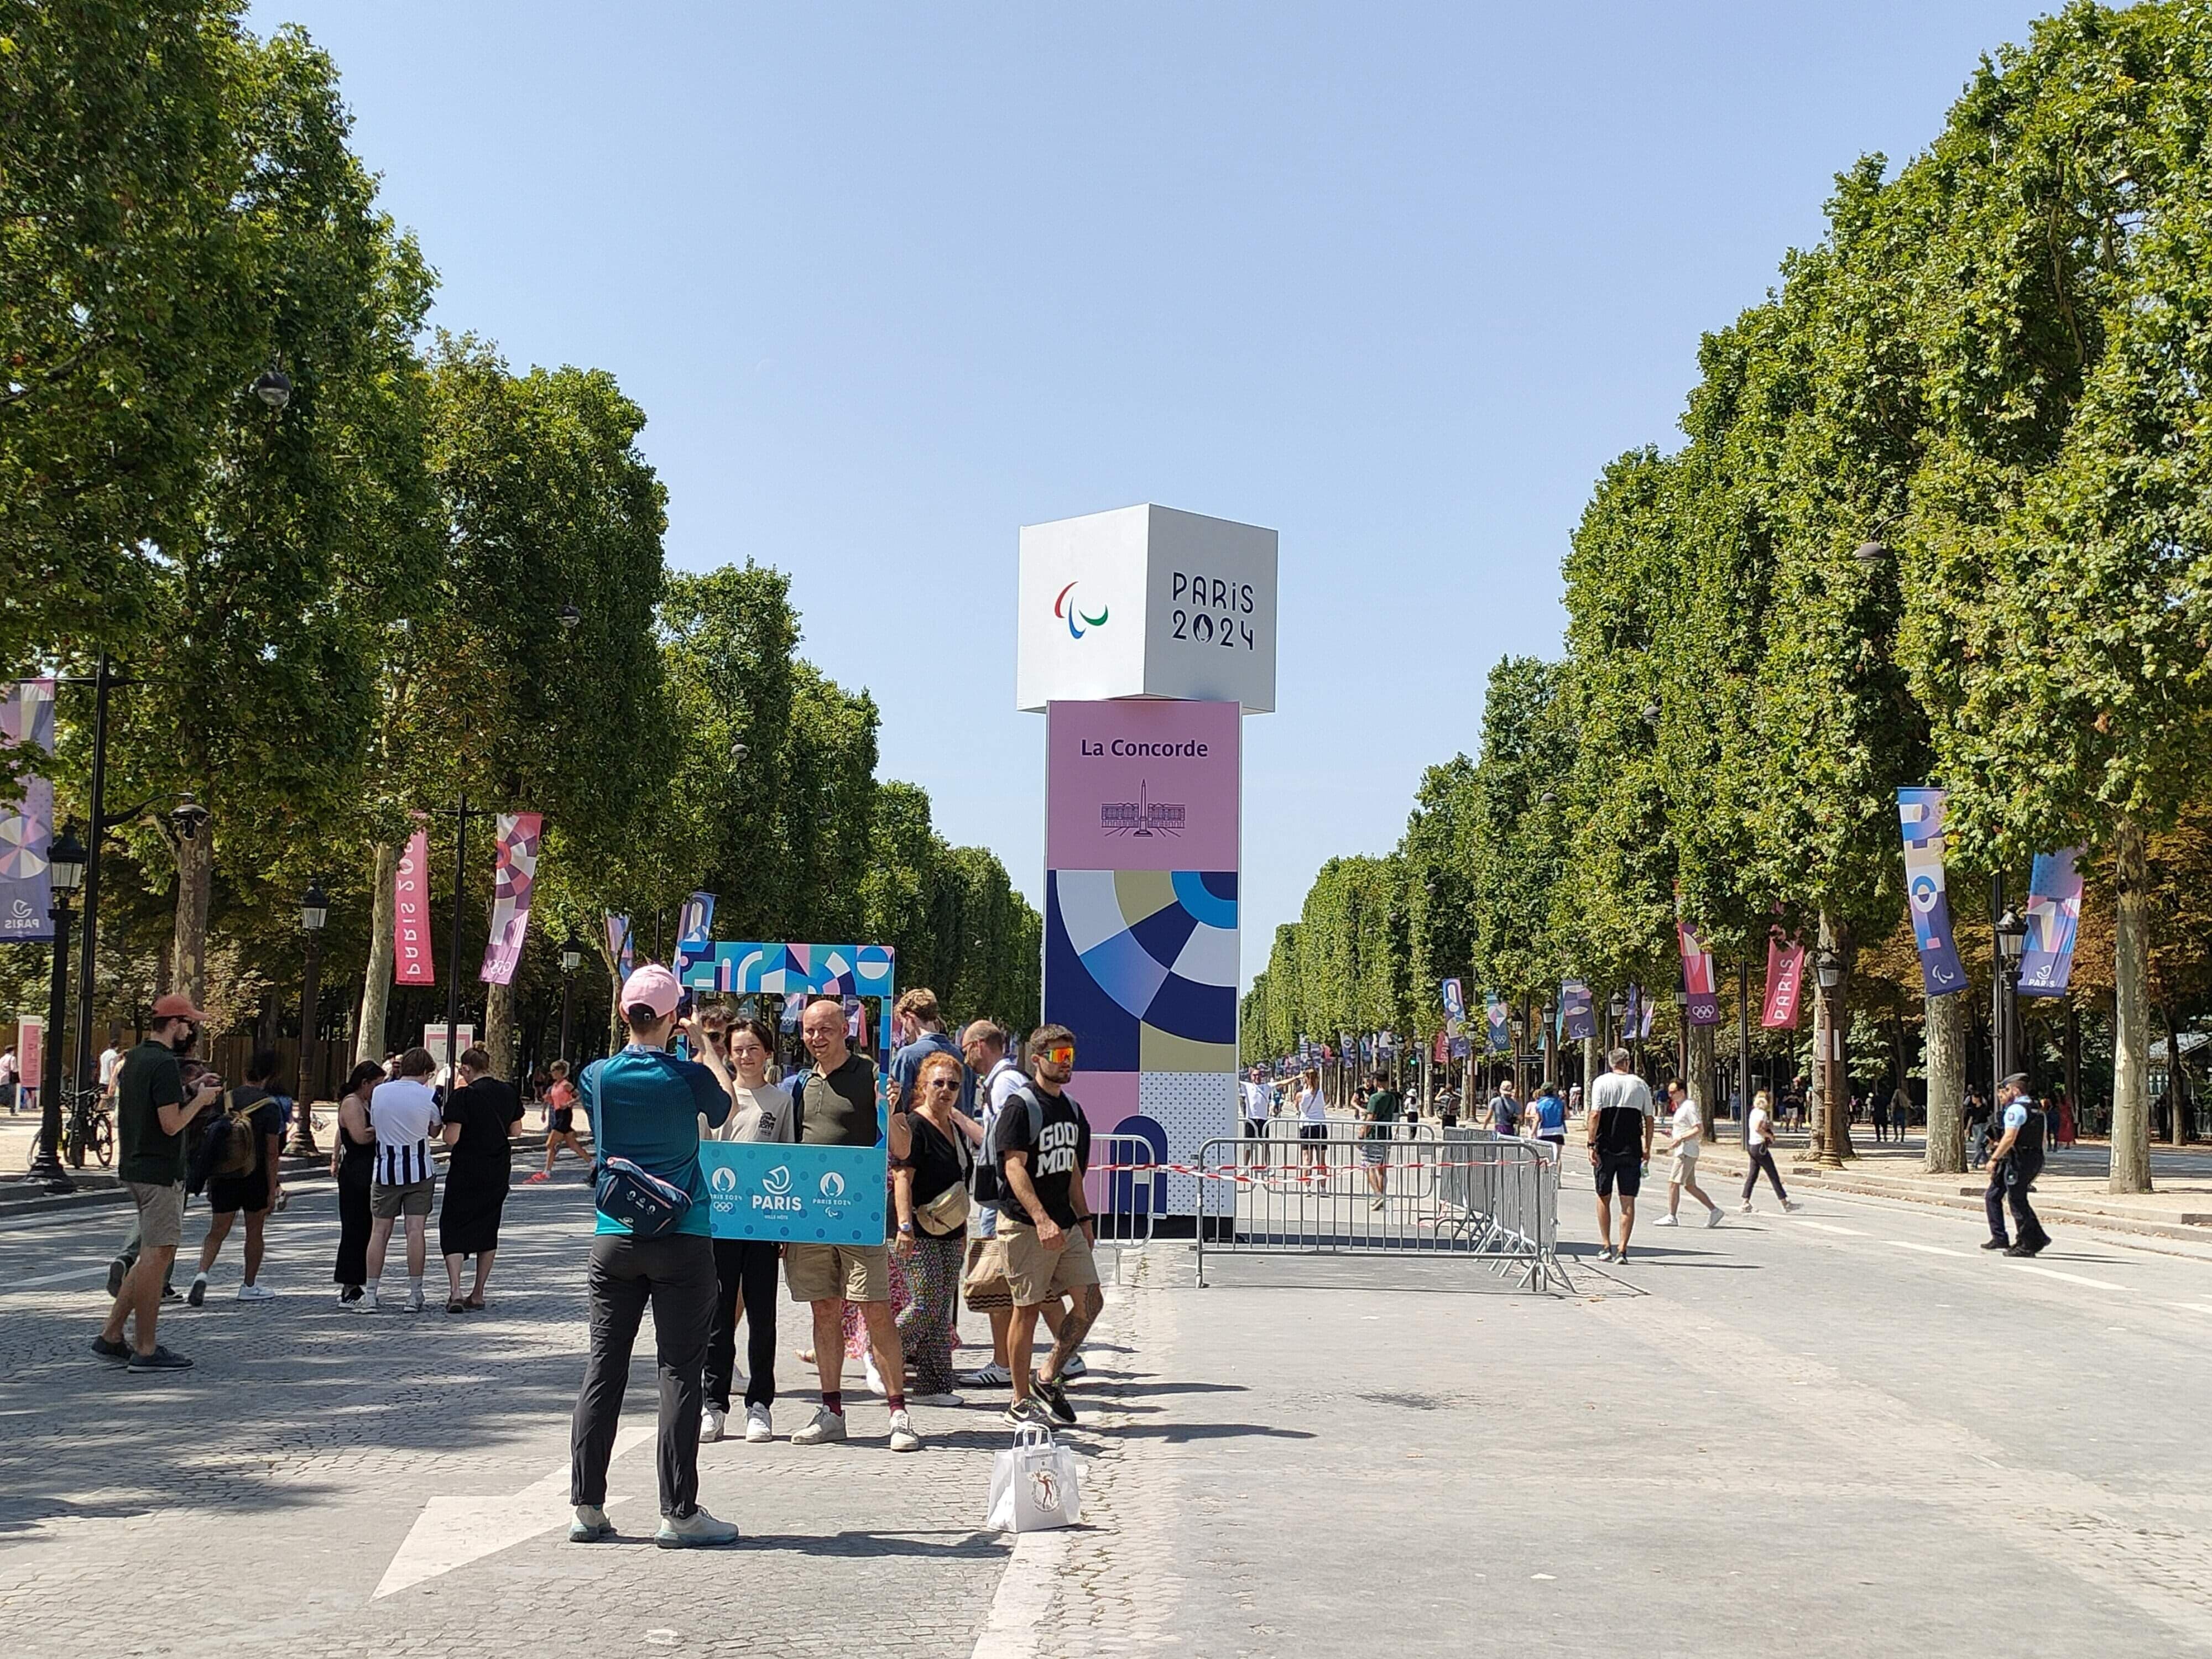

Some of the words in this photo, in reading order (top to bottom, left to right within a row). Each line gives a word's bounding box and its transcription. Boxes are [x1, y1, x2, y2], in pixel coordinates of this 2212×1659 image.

[1172, 609, 1253, 650] 2024
[1082, 739, 1104, 756] La
[1111, 739, 1208, 757] Concorde
[2028, 978, 2055, 988] PARS
[752, 1195, 802, 1211] PARIS
